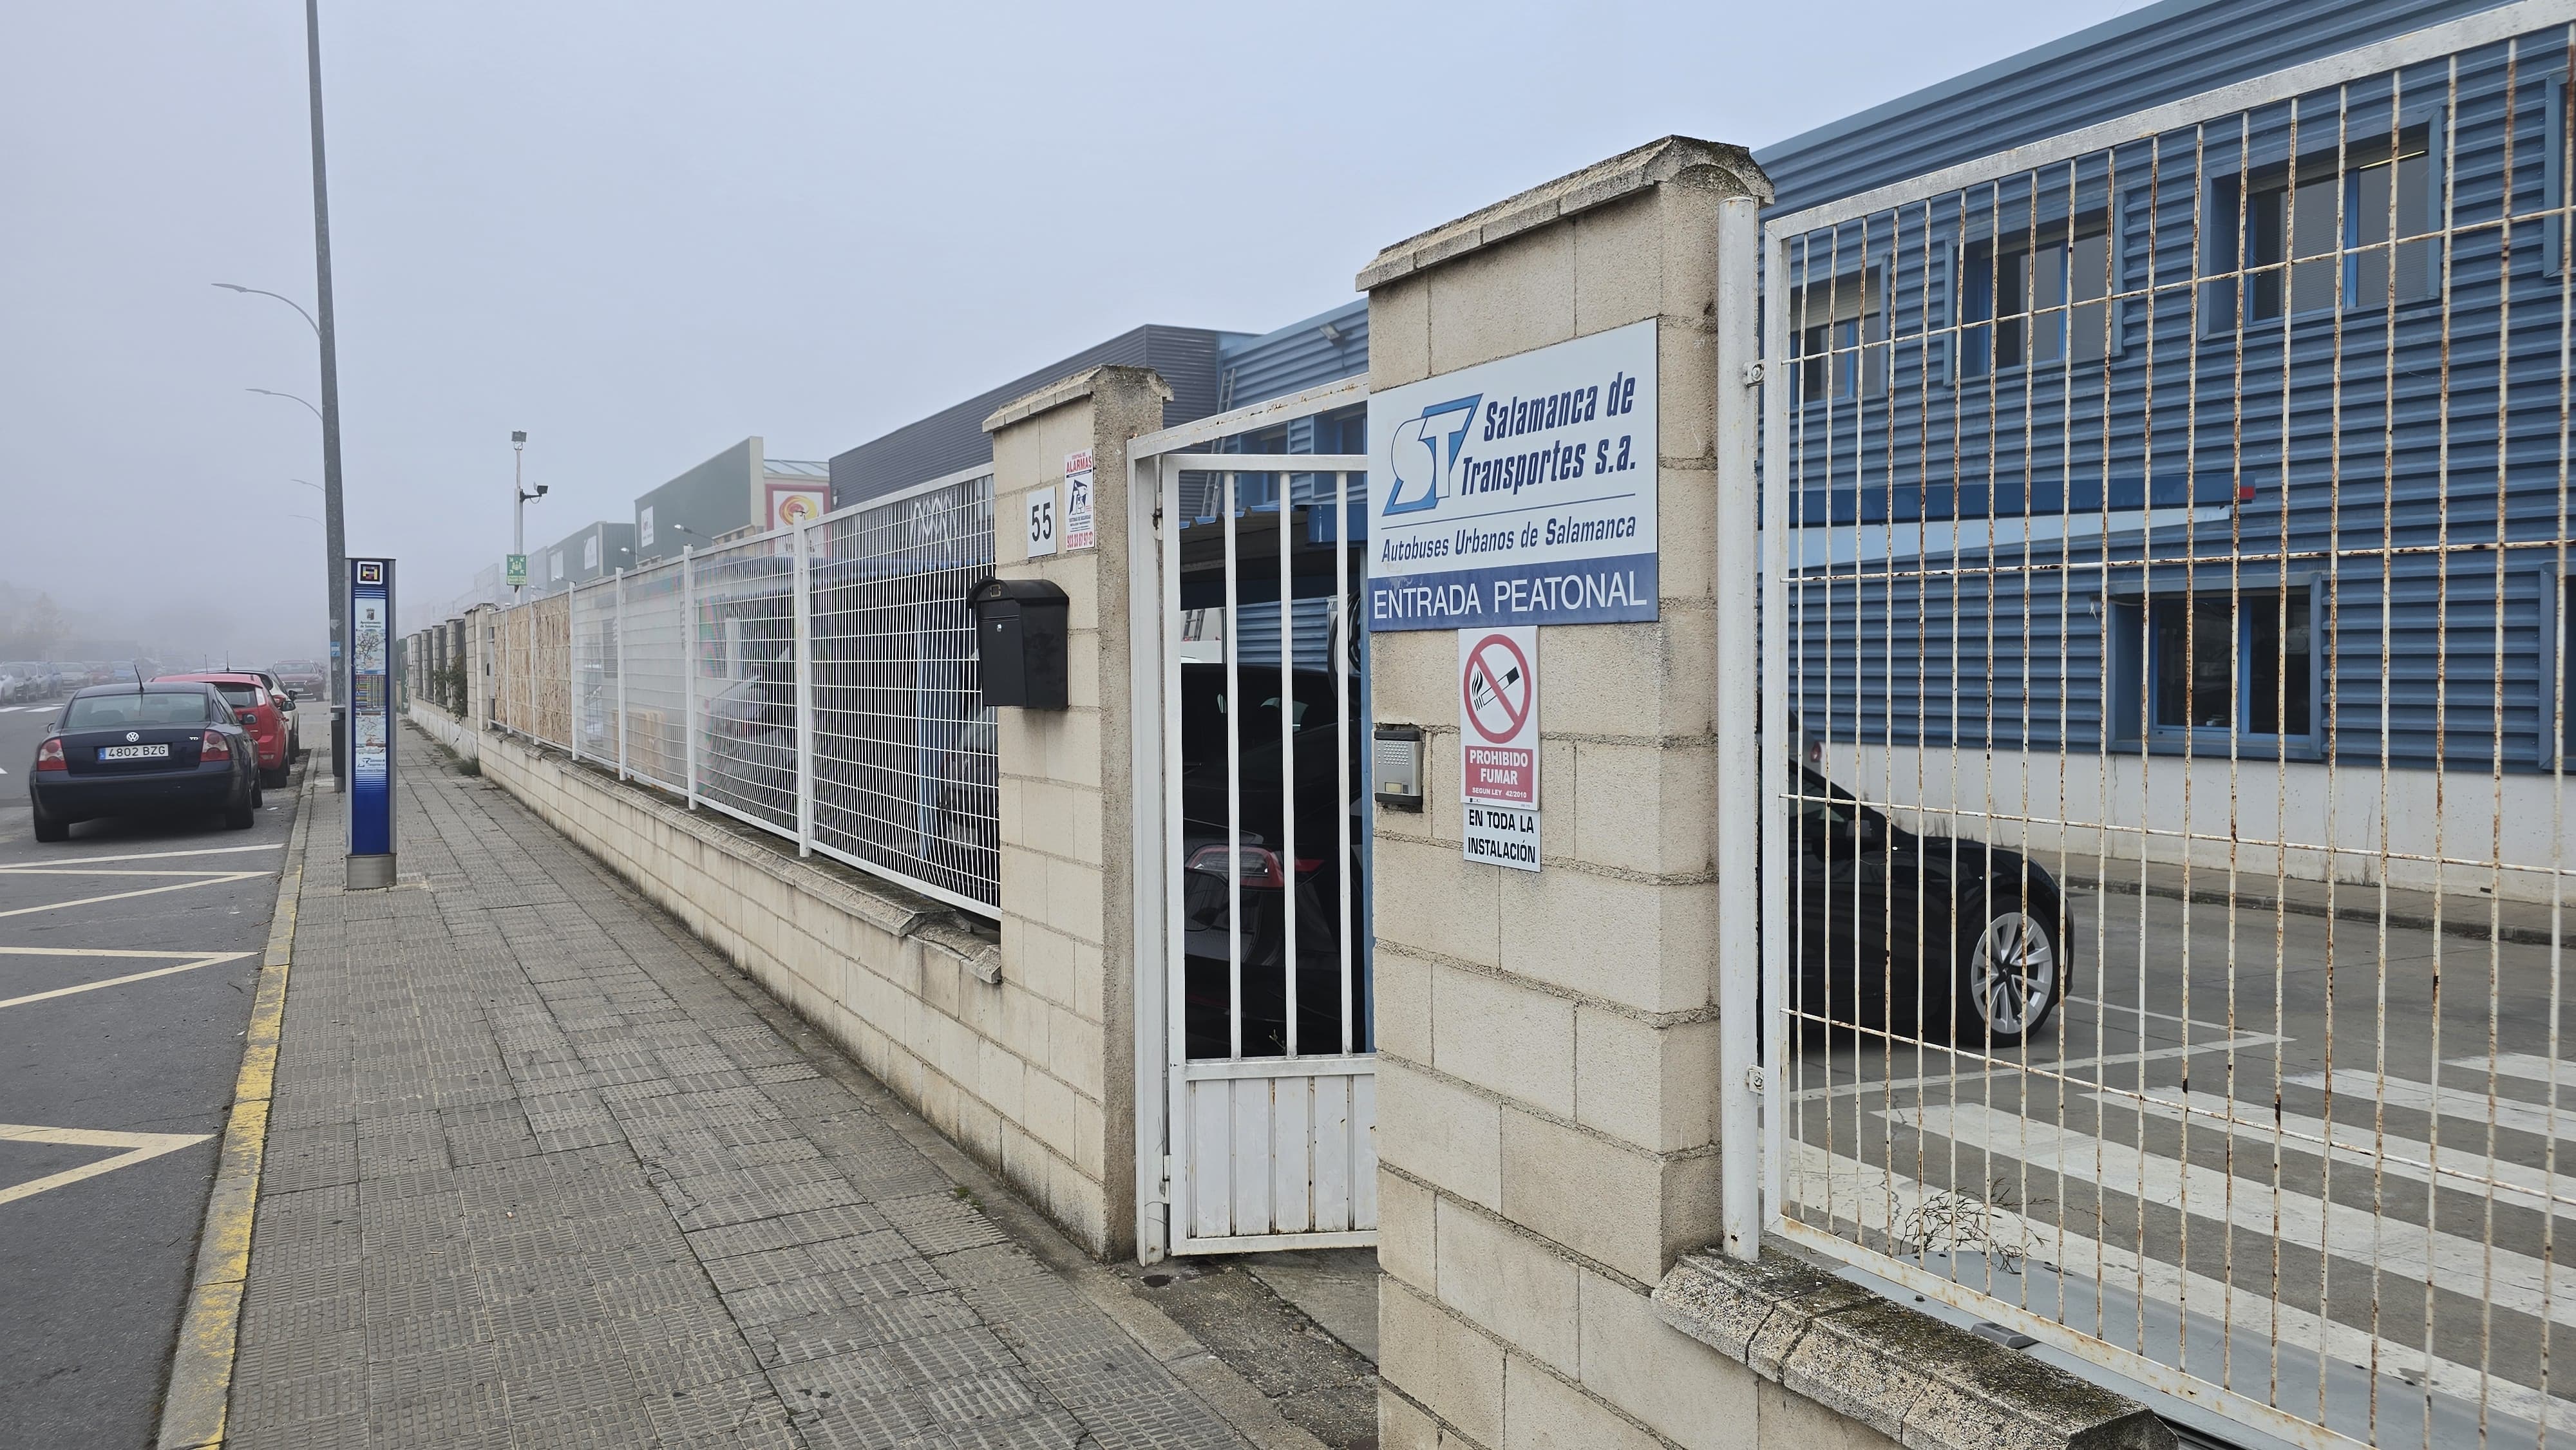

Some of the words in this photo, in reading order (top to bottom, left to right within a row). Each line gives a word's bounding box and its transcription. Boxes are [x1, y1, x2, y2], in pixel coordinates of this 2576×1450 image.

[1484, 385, 1598, 442] Salamanca
[1607, 371, 1636, 417] de
[1066, 456, 1092, 473] ALARMAS
[1383, 393, 1483, 516] ST
[1461, 440, 1586, 496] Transportes
[1595, 435, 1636, 475] s.a.
[1032, 501, 1052, 542] 55
[1381, 535, 1449, 563] Autobuses
[1455, 530, 1514, 556] Urbanos
[1520, 522, 1538, 547] de
[1546, 516, 1636, 545] Salamanca
[1374, 583, 1482, 619] ENTRADA
[1494, 570, 1647, 614] PEATONAL
[108, 746, 139, 757] 4802
[142, 746, 166, 756] BZG
[1470, 749, 1528, 767] PROHIBIDO
[1480, 768, 1518, 785] FUMAR
[1472, 787, 1490, 795] SEGUN
[1469, 809, 1482, 827] EN
[1487, 811, 1515, 831] TODA
[1520, 816, 1534, 834] LA
[1468, 836, 1535, 863] INSTALACIÓN
